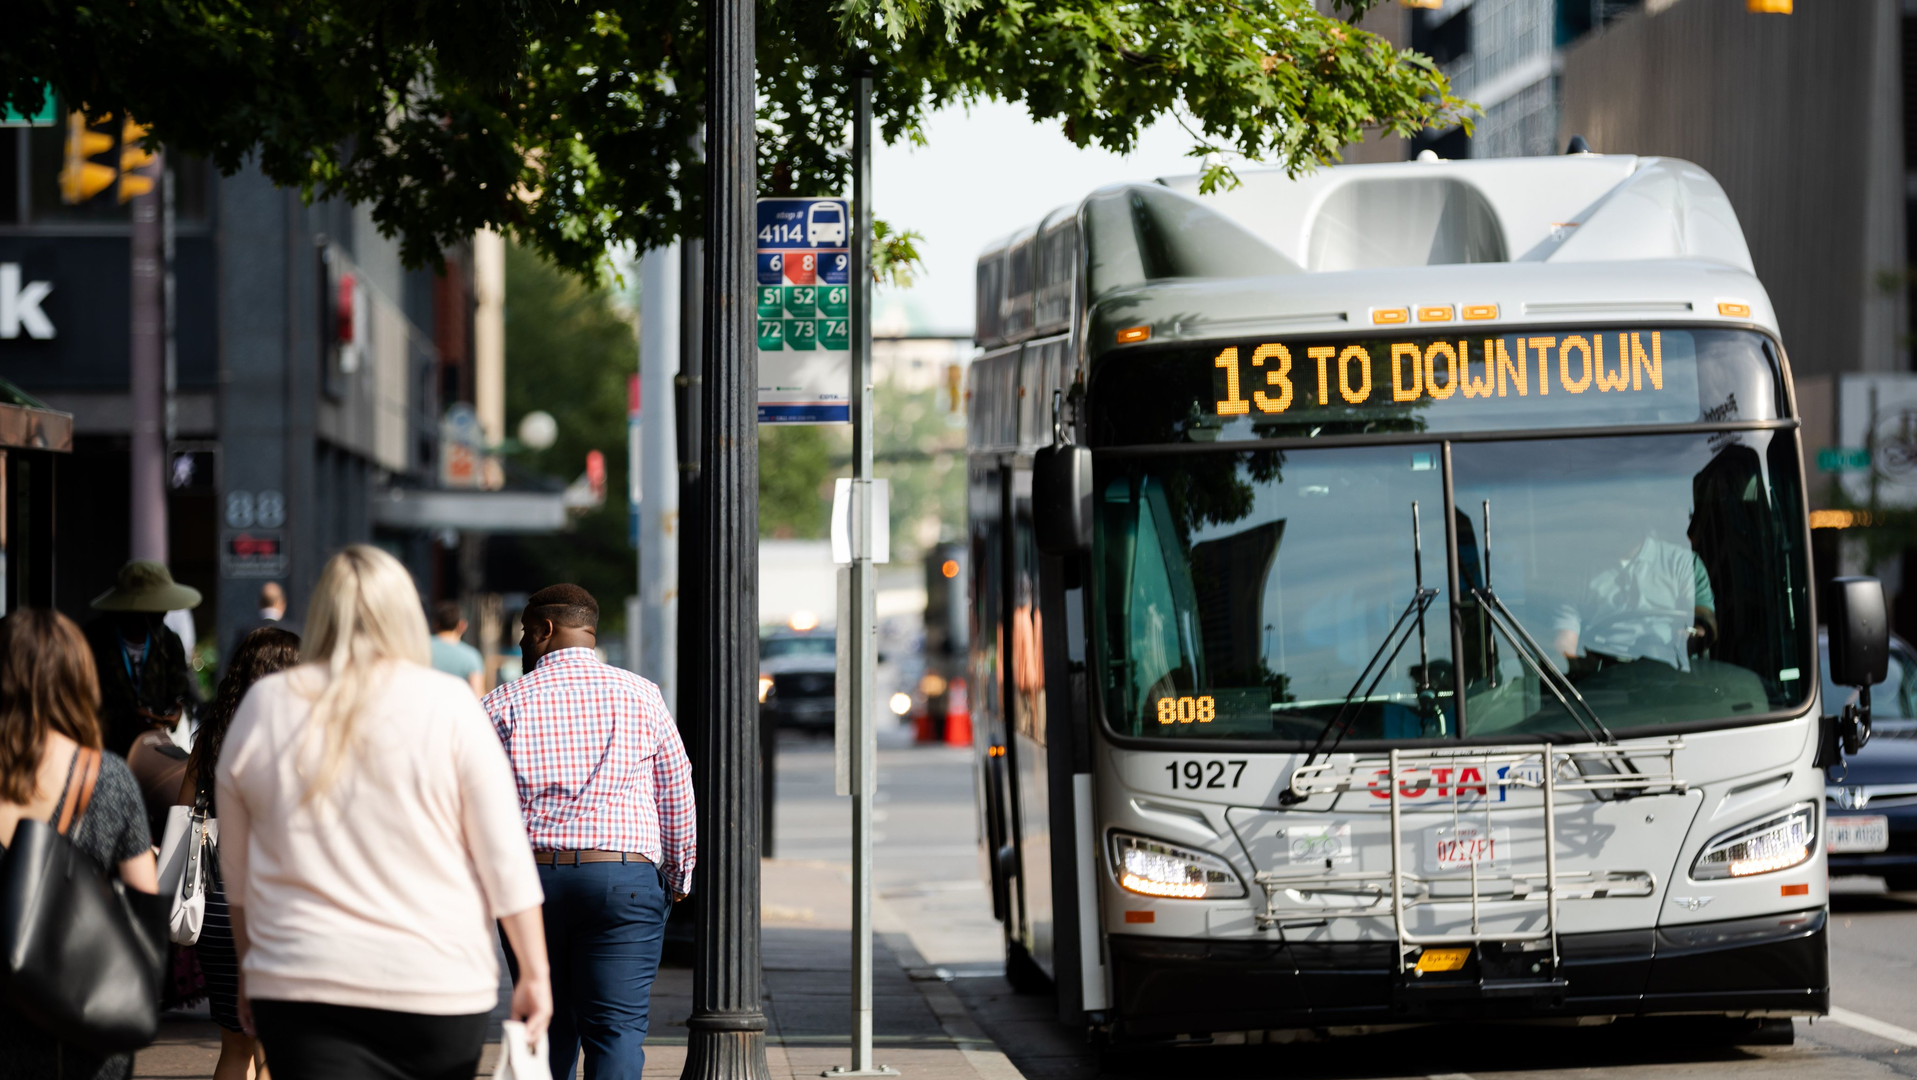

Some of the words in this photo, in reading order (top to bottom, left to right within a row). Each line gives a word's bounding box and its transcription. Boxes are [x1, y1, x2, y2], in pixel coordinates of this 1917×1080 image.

[758, 223, 803, 243] 4114
[769, 254, 782, 272] 6
[802, 254, 814, 271] 8
[835, 254, 847, 271] 9
[763, 287, 781, 305] 51
[793, 287, 814, 304] 52
[828, 287, 847, 304] 61
[761, 321, 782, 338] 72
[794, 321, 815, 337] 73
[825, 321, 848, 337] 74
[1214, 343, 1293, 415] 13
[1307, 345, 1372, 405] TO
[1391, 331, 1663, 402] DOWNTOWN
[1157, 695, 1216, 725] 808
[1165, 760, 1248, 790] 1927
